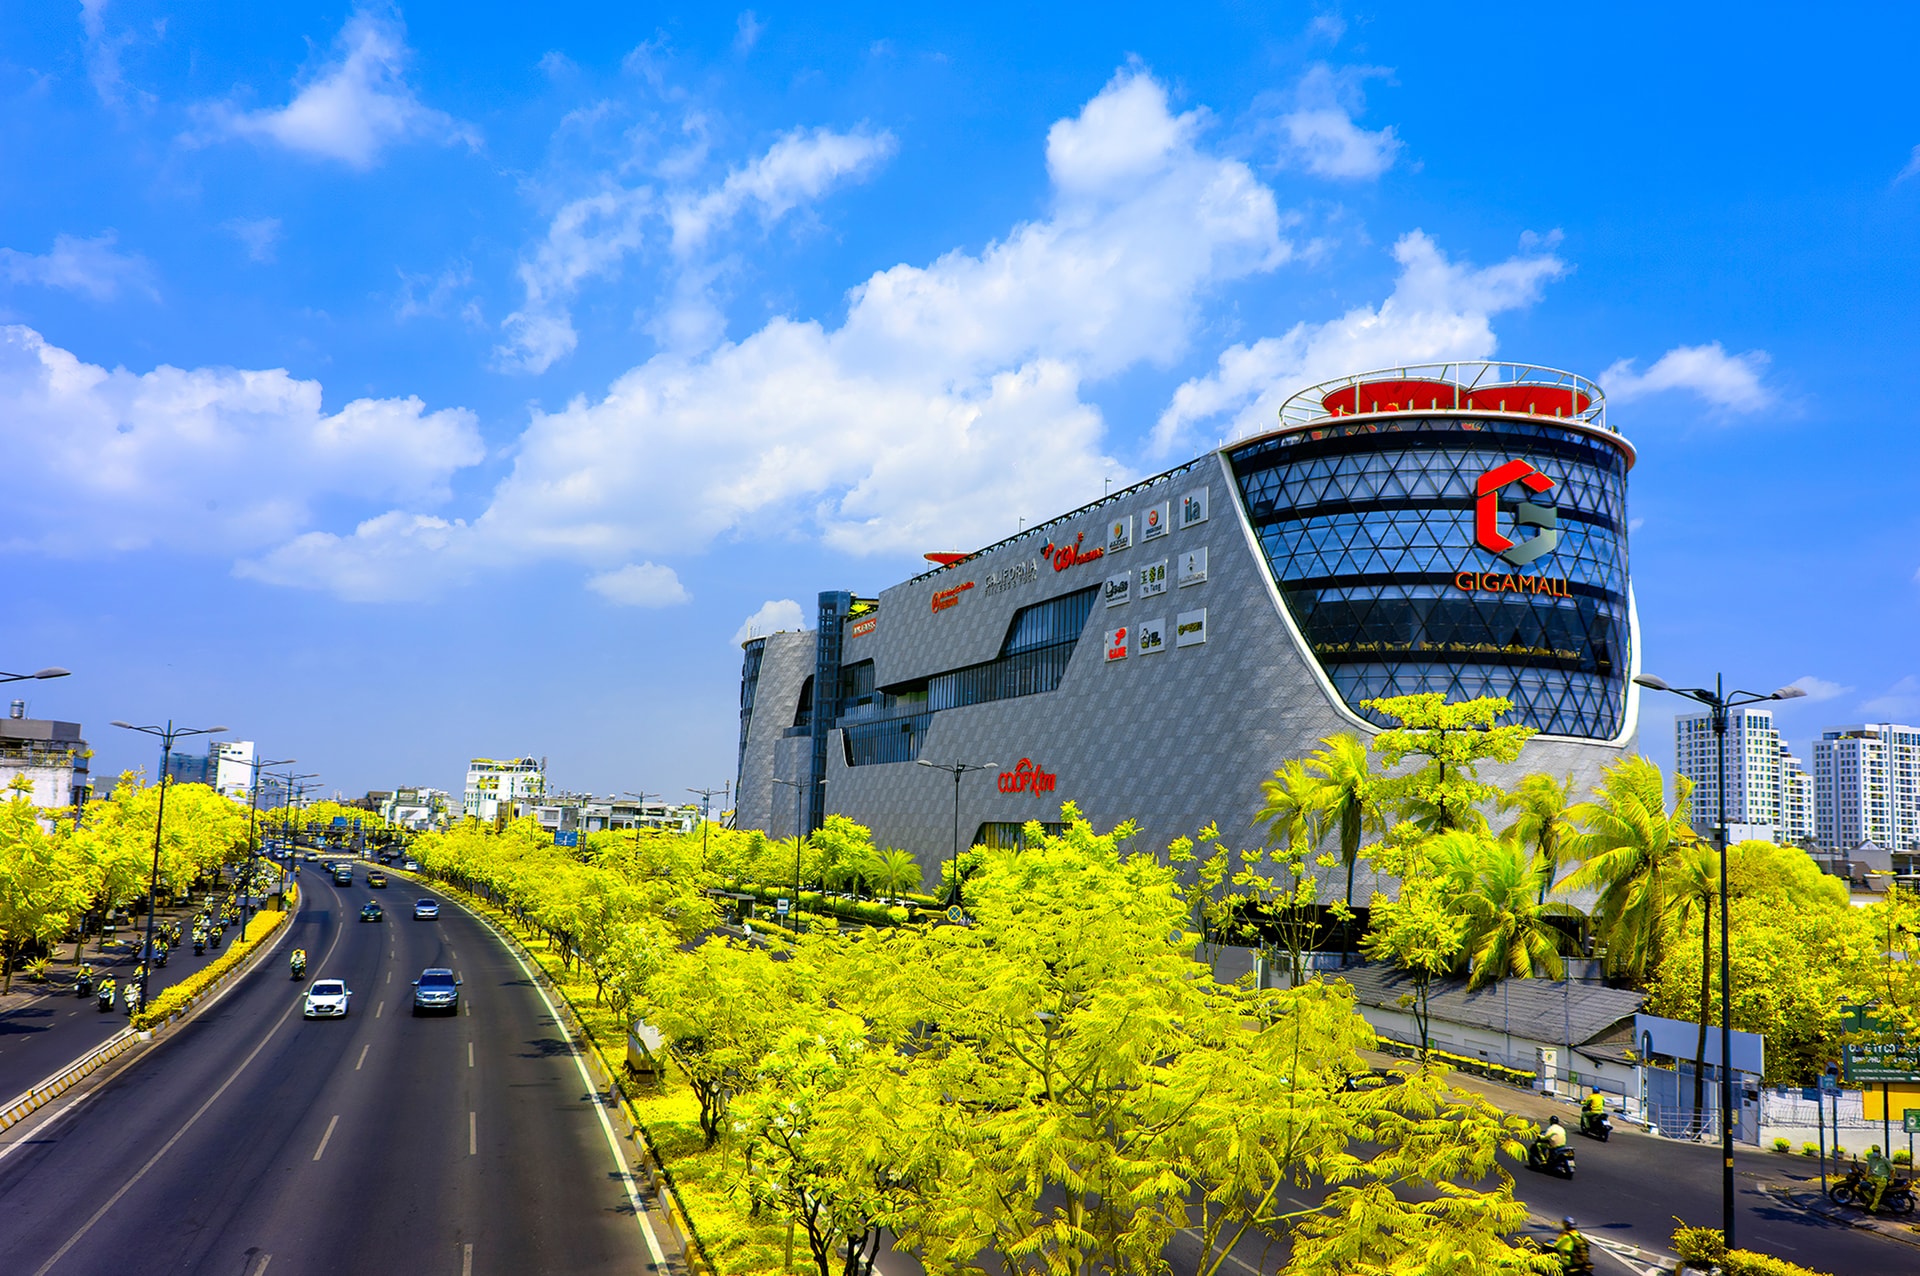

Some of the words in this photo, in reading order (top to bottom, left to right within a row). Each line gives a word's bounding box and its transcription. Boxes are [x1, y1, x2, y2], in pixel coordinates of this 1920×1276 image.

[1184, 496, 1201, 522] ila
[1053, 542, 1079, 573] CGV
[985, 558, 1037, 588] CALIFORNIA
[1455, 571, 1573, 598] GIGAMALL
